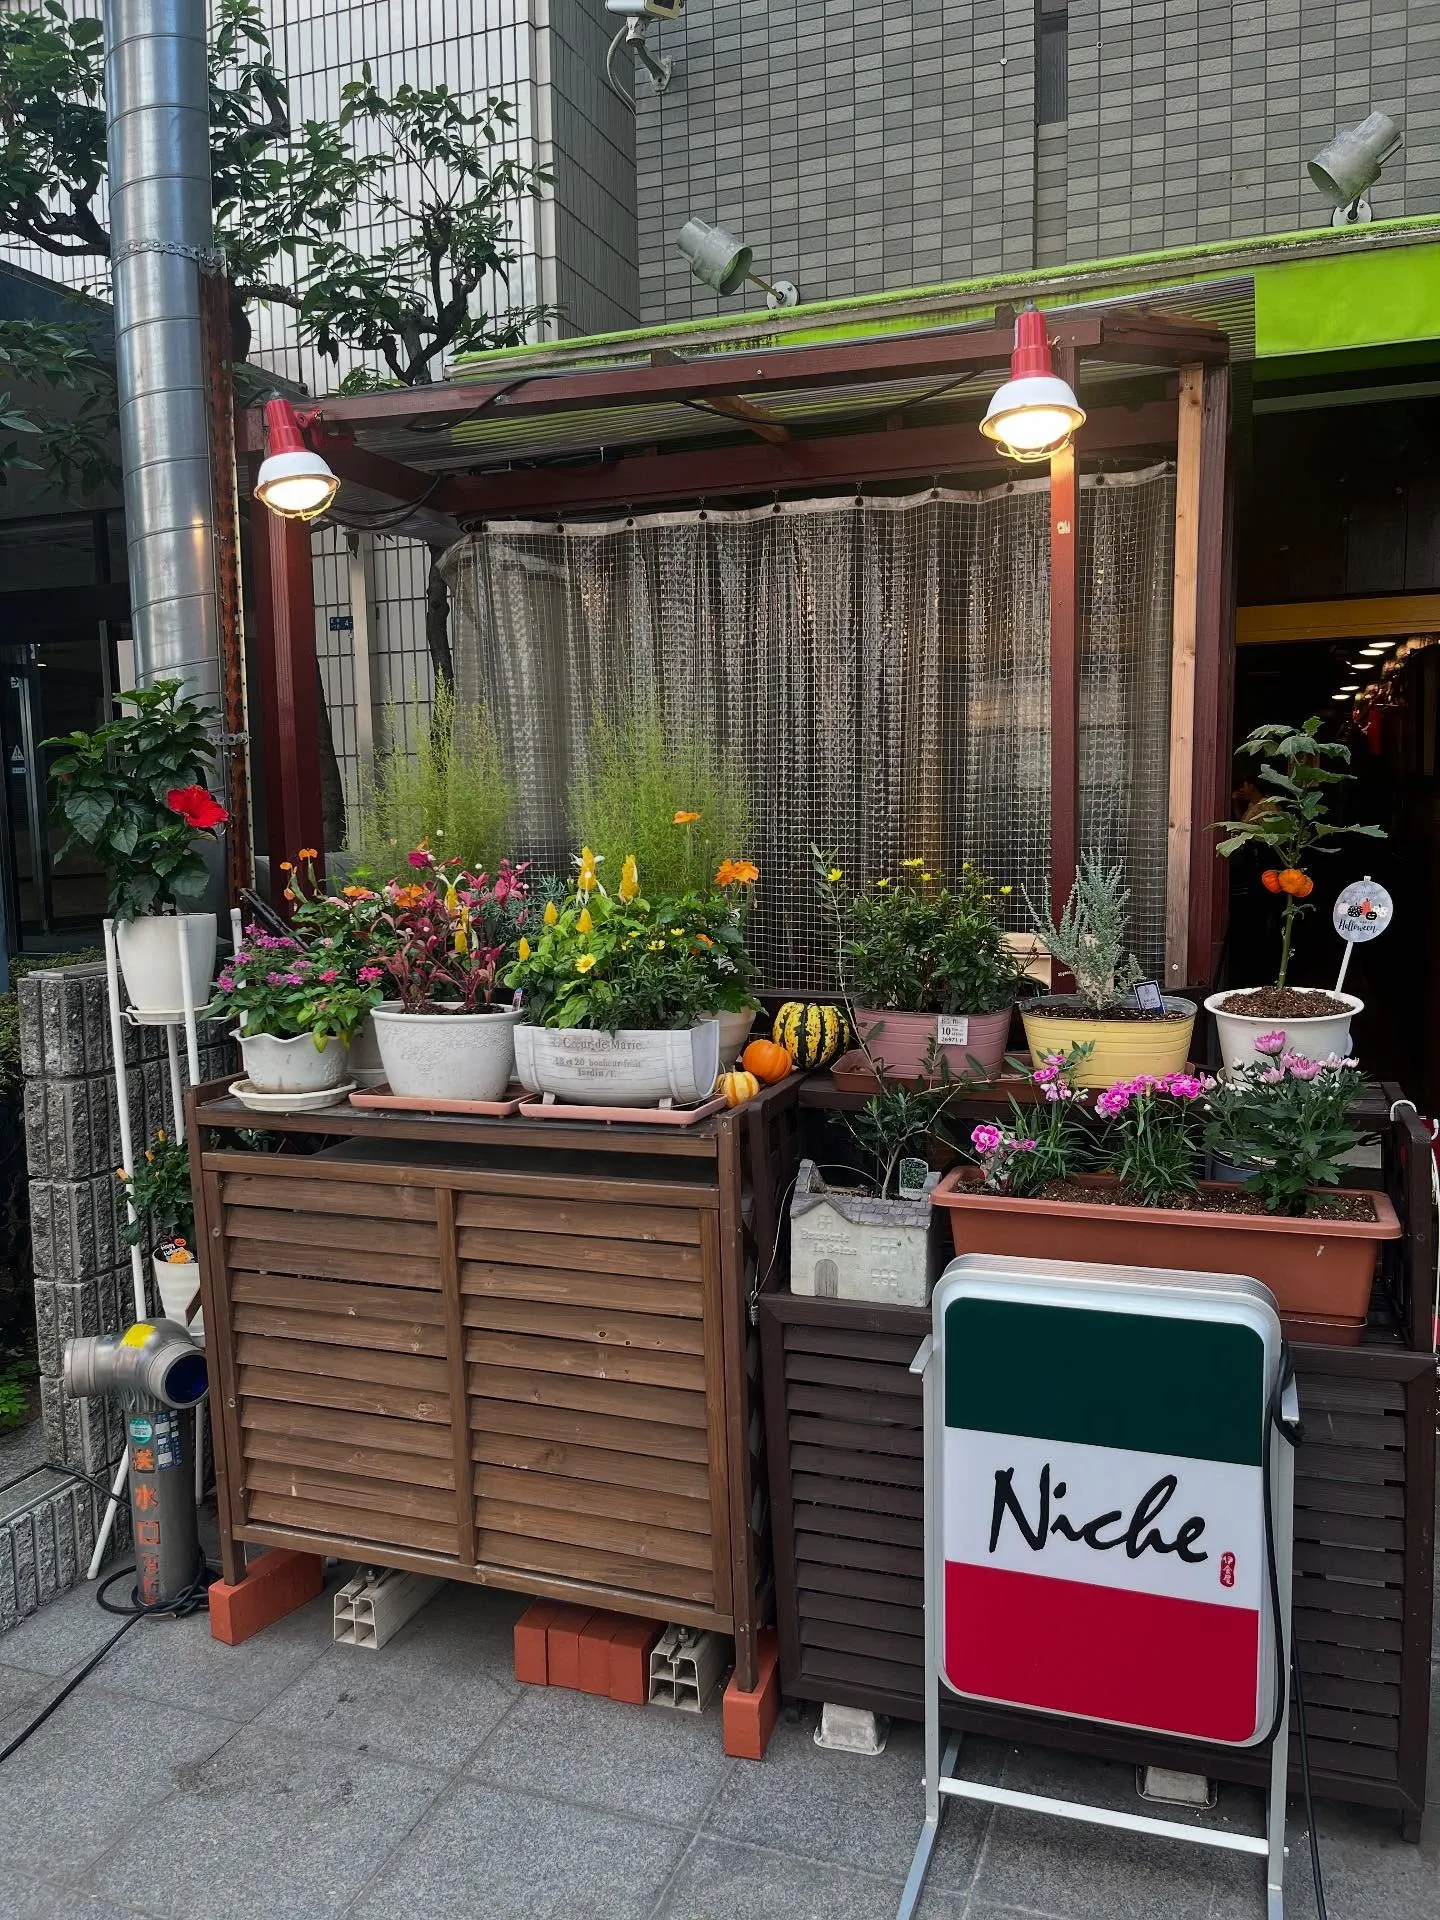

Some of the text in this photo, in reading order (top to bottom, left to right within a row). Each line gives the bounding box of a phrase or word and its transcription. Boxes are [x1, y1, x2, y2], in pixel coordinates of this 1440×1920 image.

[942, 1027, 951, 1036] 10
[594, 1037, 608, 1050] de
[574, 1057, 585, 1066] 20
[989, 1463, 1208, 1563] Niche
